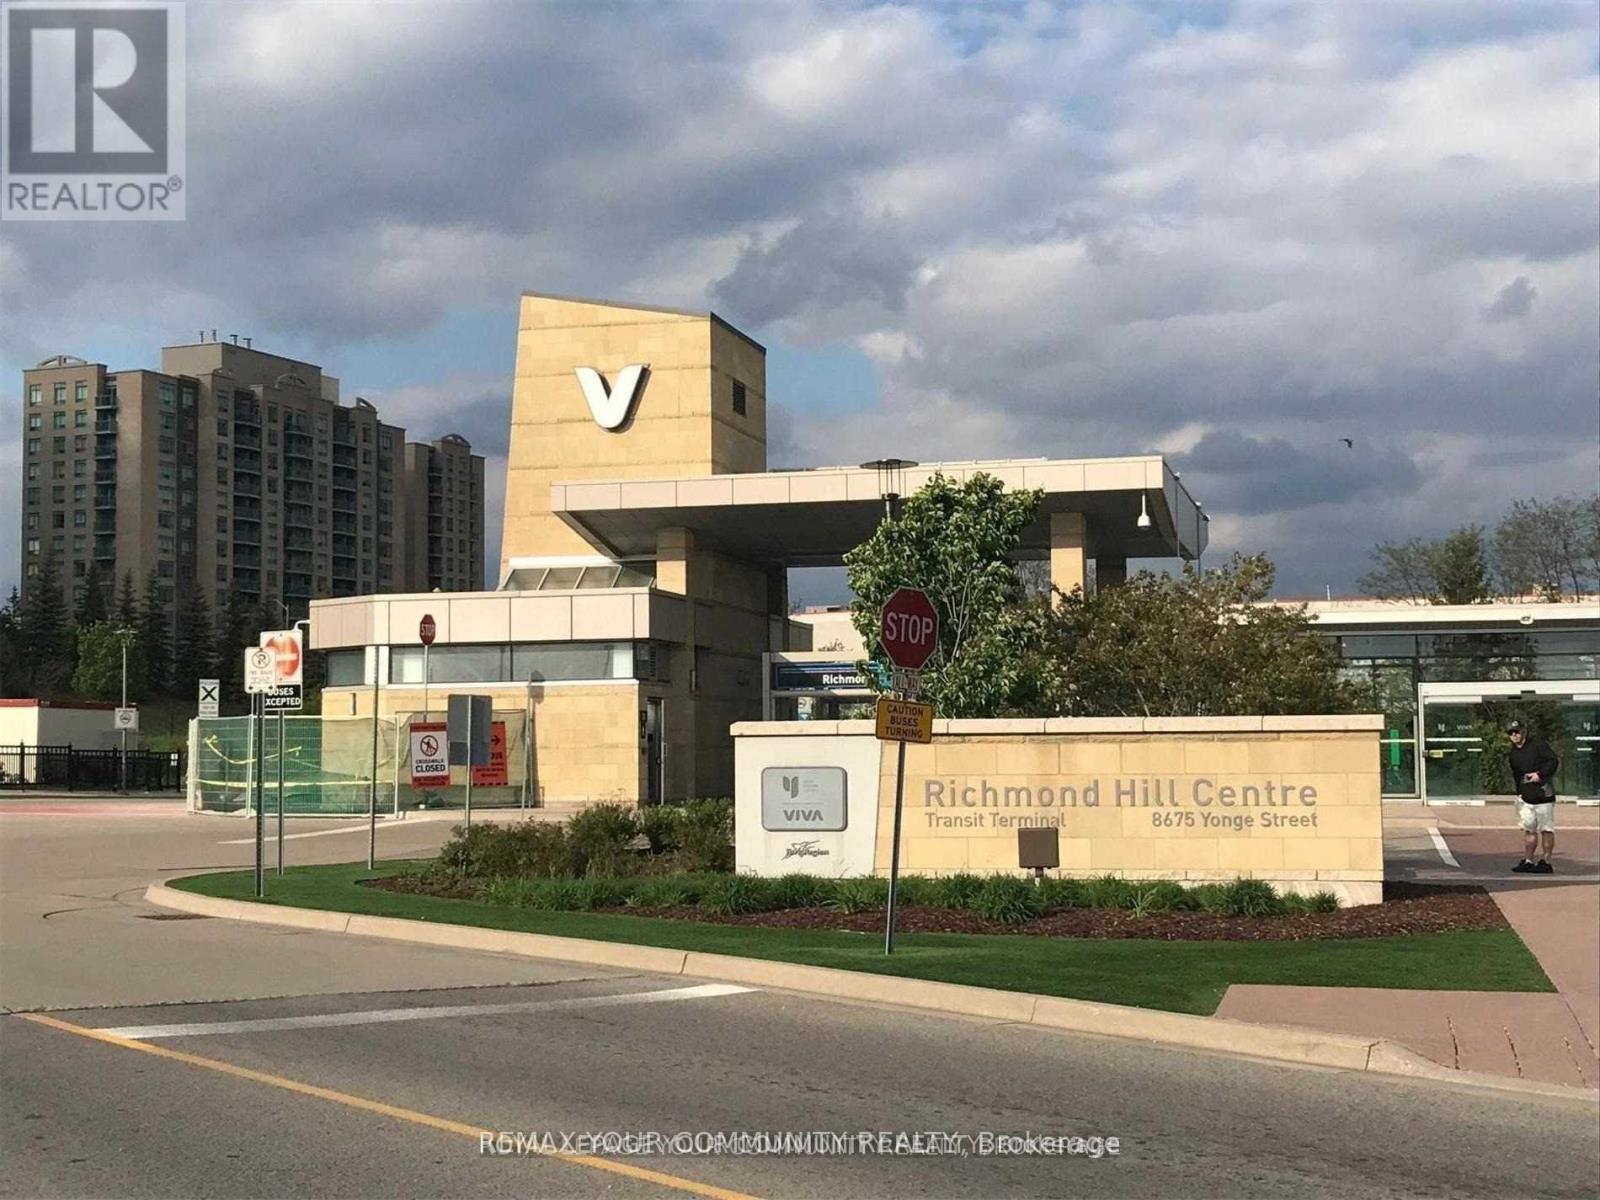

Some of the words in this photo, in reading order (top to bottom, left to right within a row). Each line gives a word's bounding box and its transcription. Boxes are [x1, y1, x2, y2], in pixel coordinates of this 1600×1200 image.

[420, 623, 435, 637] STOP
[885, 611, 933, 645] STOP
[265, 697, 301, 706] XCEPTED
[886, 704, 924, 717] CAUTION
[890, 716, 919, 727] BUSES
[885, 726, 923, 739] TURNING
[415, 764, 446, 773] CLOSED
[925, 779, 1099, 807] Richmond
[1115, 779, 1179, 807] Hill
[1193, 778, 1317, 807] Centre
[783, 809, 824, 821] VIVA
[925, 812, 984, 828] Transit
[989, 812, 1066, 828] Terminal
[1152, 811, 1195, 828] 8675
[1201, 811, 1254, 831] Yonge
[1260, 811, 1318, 828] Street
